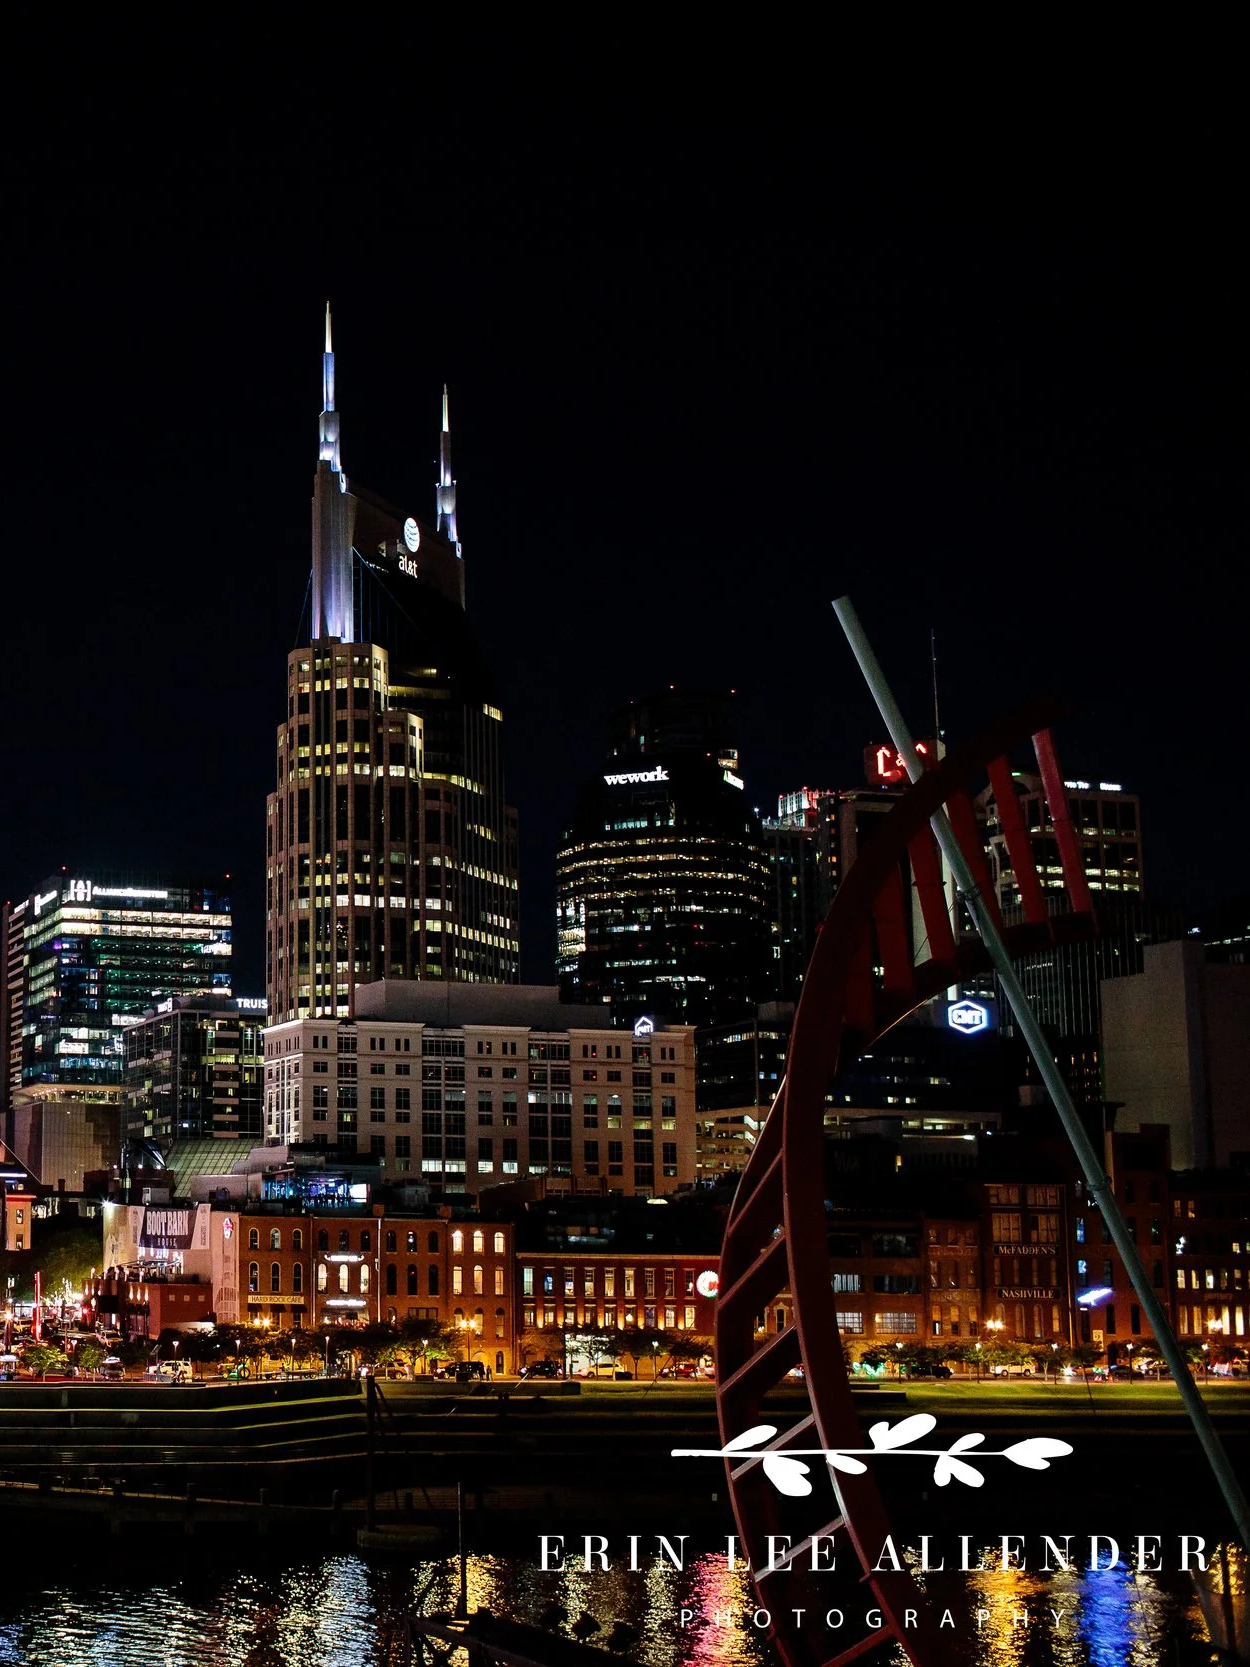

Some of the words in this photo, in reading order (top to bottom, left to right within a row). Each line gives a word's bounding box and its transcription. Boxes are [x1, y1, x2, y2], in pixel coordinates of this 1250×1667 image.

[604, 765, 669, 785] wework
[236, 998, 268, 1009] TRUIS
[146, 1211, 166, 1236] BOOT
[167, 1211, 189, 1236] BARN
[157, 1238, 177, 1248] HOUSE
[999, 1246, 1056, 1255] McFADDEN'S
[1002, 1289, 1055, 1299] NASHVILLE
[286, 1296, 302, 1304] CAFE
